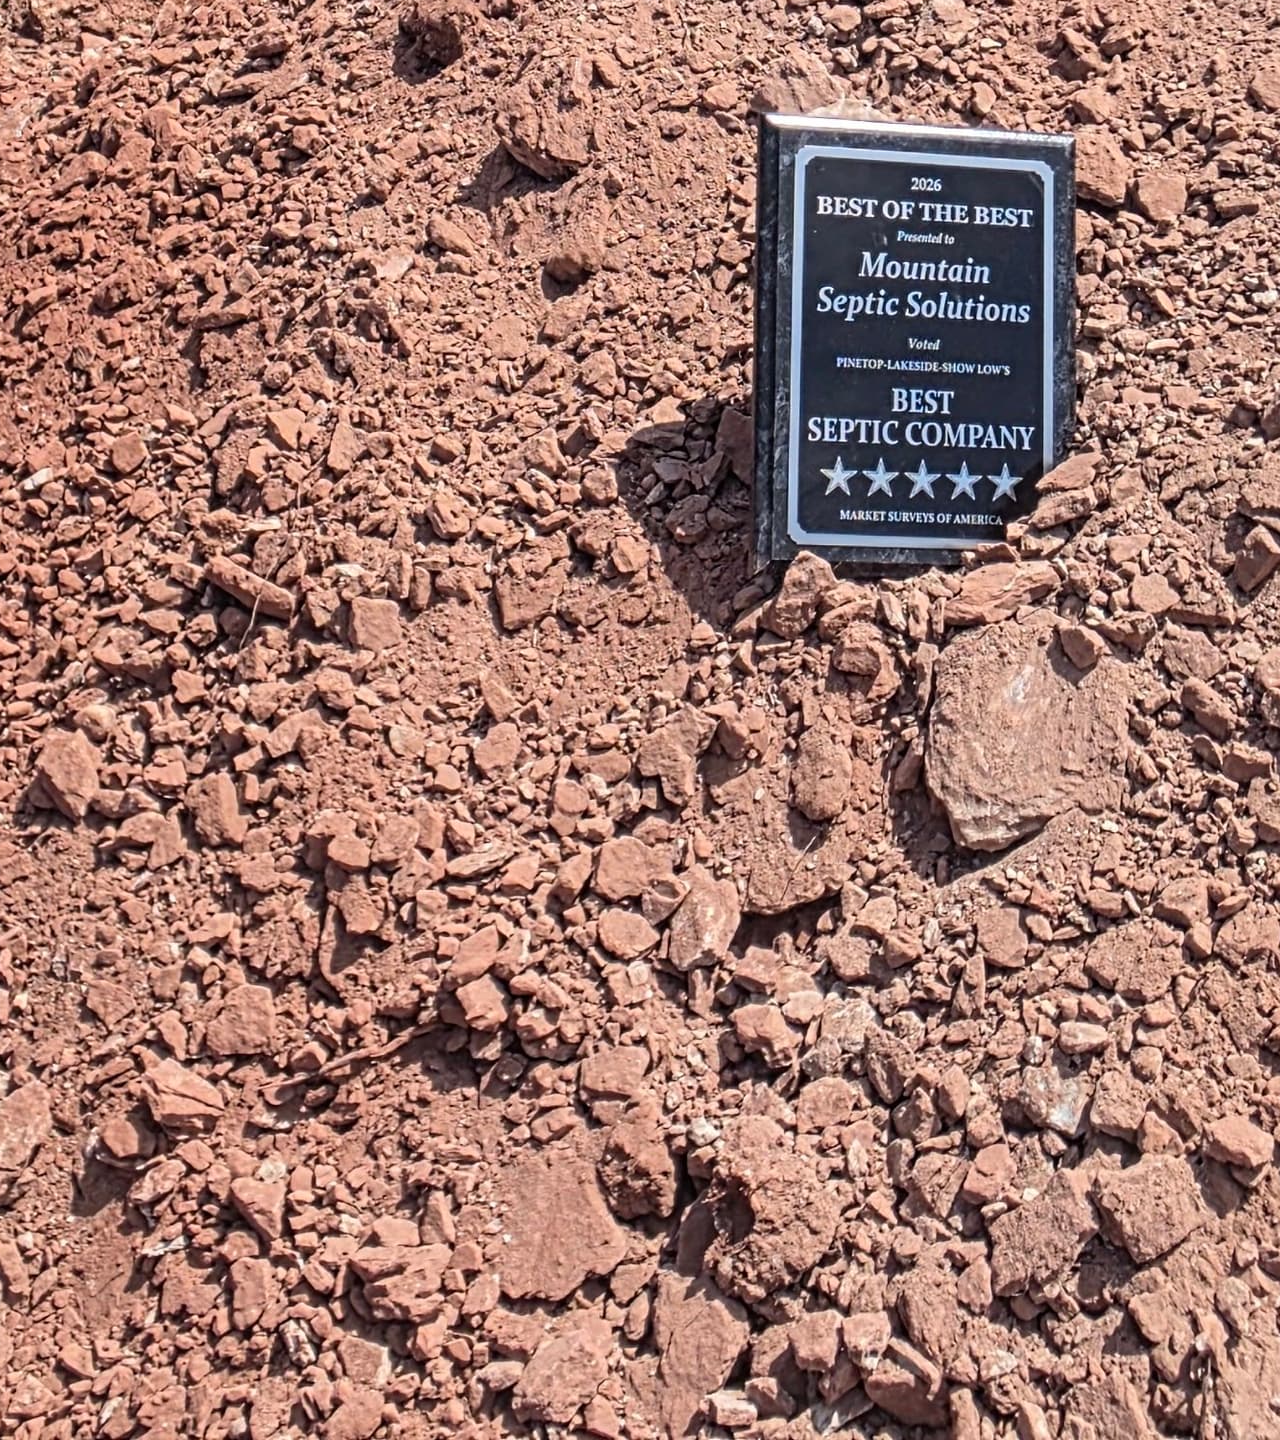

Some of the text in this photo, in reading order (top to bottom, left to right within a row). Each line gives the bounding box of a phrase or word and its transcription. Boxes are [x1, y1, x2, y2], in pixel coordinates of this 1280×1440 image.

[911, 177, 942, 192] 2026
[816, 195, 1034, 228] BEST OF THE BEST
[896, 230, 955, 245] Presented to
[858, 251, 990, 284] Mountain
[817, 286, 1031, 324] Septic Solutions
[908, 337, 941, 351] Voted
[836, 357, 1011, 376] PINETOP-LAKESIDE-SHOW LOW'S
[891, 387, 955, 414] BEST
[807, 416, 1036, 450] SEPTIC COMPANY
[839, 509, 1003, 526] MARKET SURVEYS OF AMERICA
